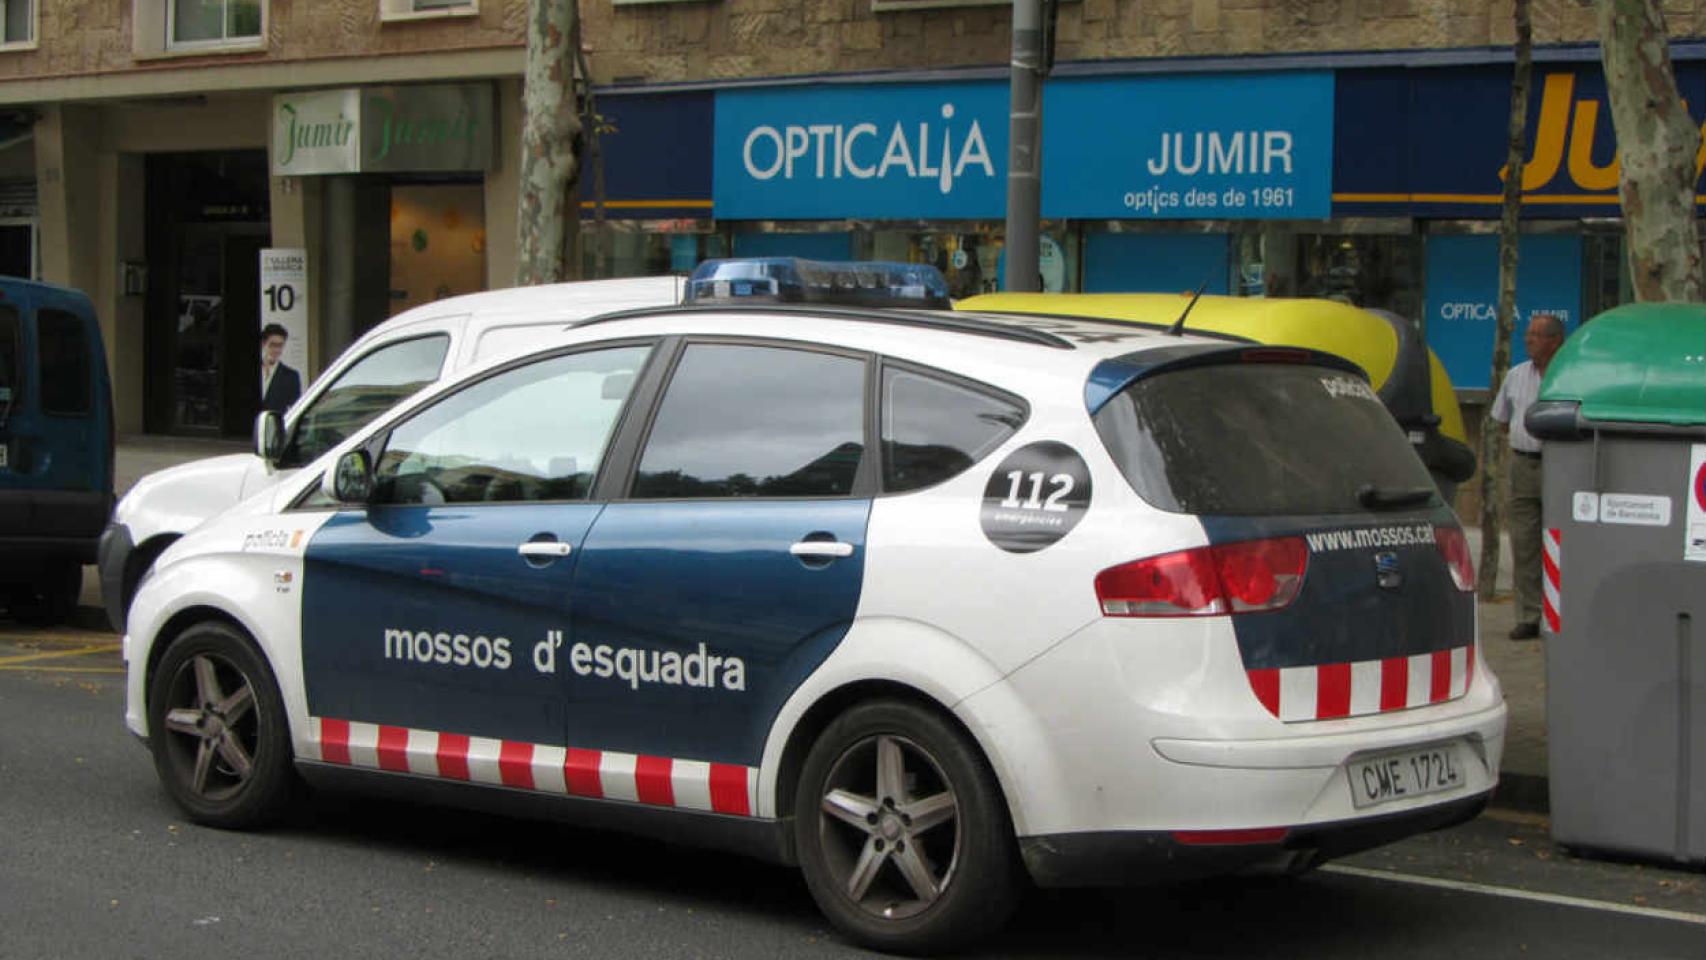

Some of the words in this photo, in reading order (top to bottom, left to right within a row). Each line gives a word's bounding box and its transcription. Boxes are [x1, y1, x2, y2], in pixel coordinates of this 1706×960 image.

[280, 103, 352, 166] Jumir
[1147, 131, 1293, 175] JUMIR
[1123, 185, 1179, 214] optics
[1184, 189, 1217, 207] des
[1222, 189, 1246, 207] de
[1252, 188, 1294, 207] 1961
[264, 284, 295, 312] 10
[1001, 470, 1074, 512] 112
[1306, 523, 1436, 553] www.mossos.cat
[384, 628, 512, 670] mossos
[570, 642, 746, 692] esquadra
[1362, 760, 1405, 799] CME
[1410, 751, 1457, 791] 1724
